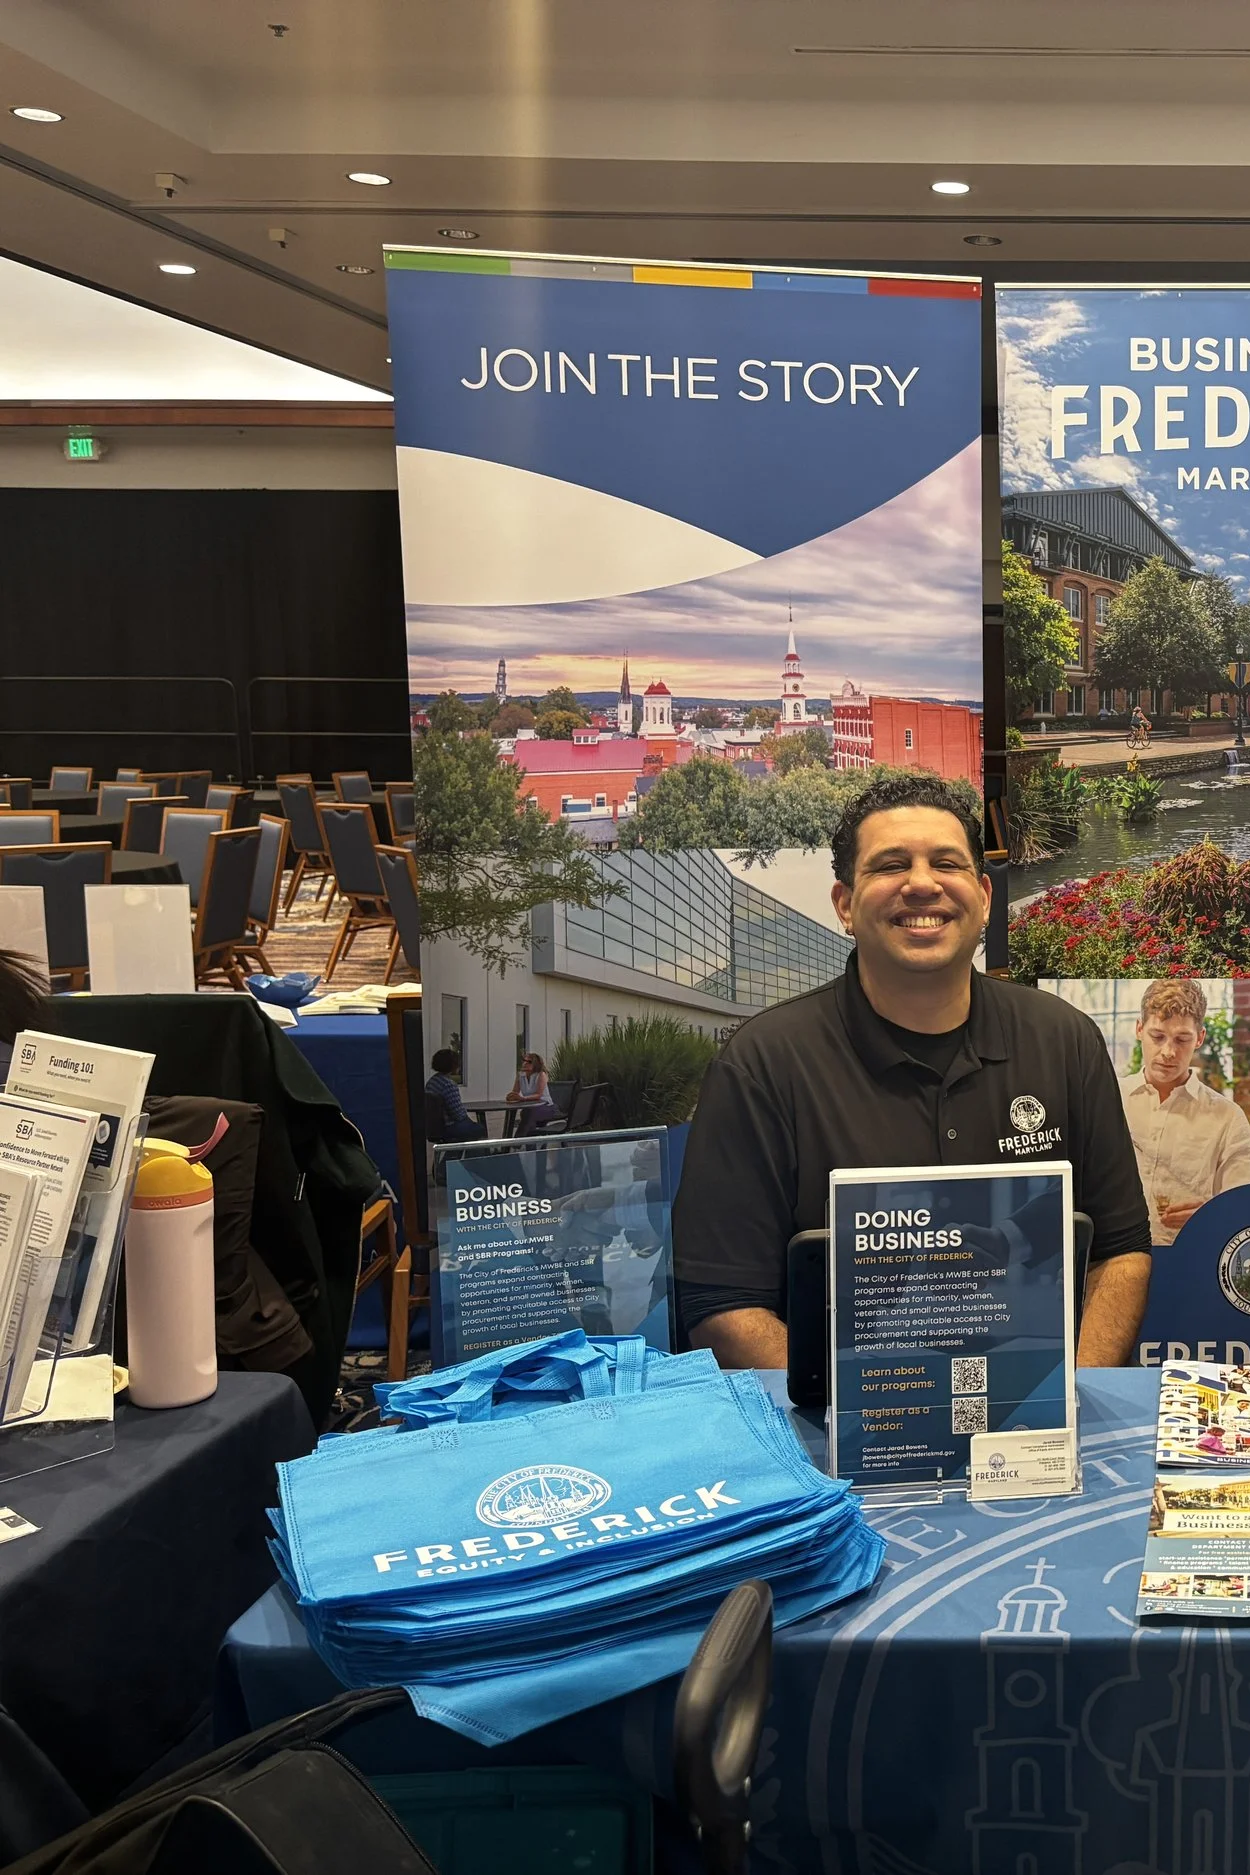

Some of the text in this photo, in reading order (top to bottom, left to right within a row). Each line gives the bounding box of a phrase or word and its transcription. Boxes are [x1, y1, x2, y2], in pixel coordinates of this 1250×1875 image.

[460, 346, 919, 407] JOIN THE STORY
[69, 439, 93, 457] EXIT
[21, 1048, 36, 1061] SBA
[49, 1056, 80, 1073] Funding
[80, 1062, 94, 1074] 101
[16, 1124, 33, 1136] SBA
[998, 1127, 1062, 1153] FREDERICK
[0, 1143, 24, 1152] onfidence
[1015, 1142, 1053, 1156] MARYLAND
[2, 1152, 15, 1160] SBA's
[16, 1155, 36, 1165] Resource
[455, 1183, 523, 1203] DOING
[149, 1198, 181, 1207] owala
[456, 1199, 552, 1222] BUSINESS
[523, 1217, 563, 1226] FREDERICK
[855, 1209, 931, 1230] DOING
[488, 1240, 512, 1248] about
[529, 1235, 554, 1243] MWBE
[855, 1229, 962, 1251] BUSINESS
[1226, 1236, 1241, 1255] CITY
[493, 1247, 534, 1257] Programs!
[854, 1257, 876, 1265] WITH
[895, 1255, 915, 1263] CITY
[916, 1254, 928, 1262] OF
[929, 1252, 974, 1261] FREDERICK
[871, 1275, 888, 1283] City
[900, 1272, 944, 1280] Frederick's
[854, 1282, 978, 1296] programs expand contracting
[854, 1297, 910, 1307] opportunities
[926, 1294, 961, 1302] minority,
[909, 1306, 931, 1314] small
[962, 1303, 1007, 1311] businesses
[854, 1321, 865, 1329] by
[867, 1318, 910, 1328] promoting
[912, 1317, 951, 1326] equitable
[994, 1313, 1011, 1322] City
[854, 1331, 909, 1341] procurement
[911, 1329, 927, 1337] and
[929, 1326, 973, 1337] supporting
[854, 1339, 965, 1352] growth of local businesses.
[862, 1366, 925, 1377] Learn about
[882, 1380, 935, 1392] programs:
[862, 1408, 905, 1419] Register
[908, 1407, 920, 1415] as
[862, 1422, 903, 1432] Vendor:
[975, 1470, 1019, 1481] FREDERICK
[484, 1486, 498, 1503] THE
[496, 1473, 519, 1492] CITY
[520, 1469, 535, 1478] OF
[372, 1480, 742, 1574] FREDERICK
[416, 1512, 716, 1579] EQUITY & INCLUSION
